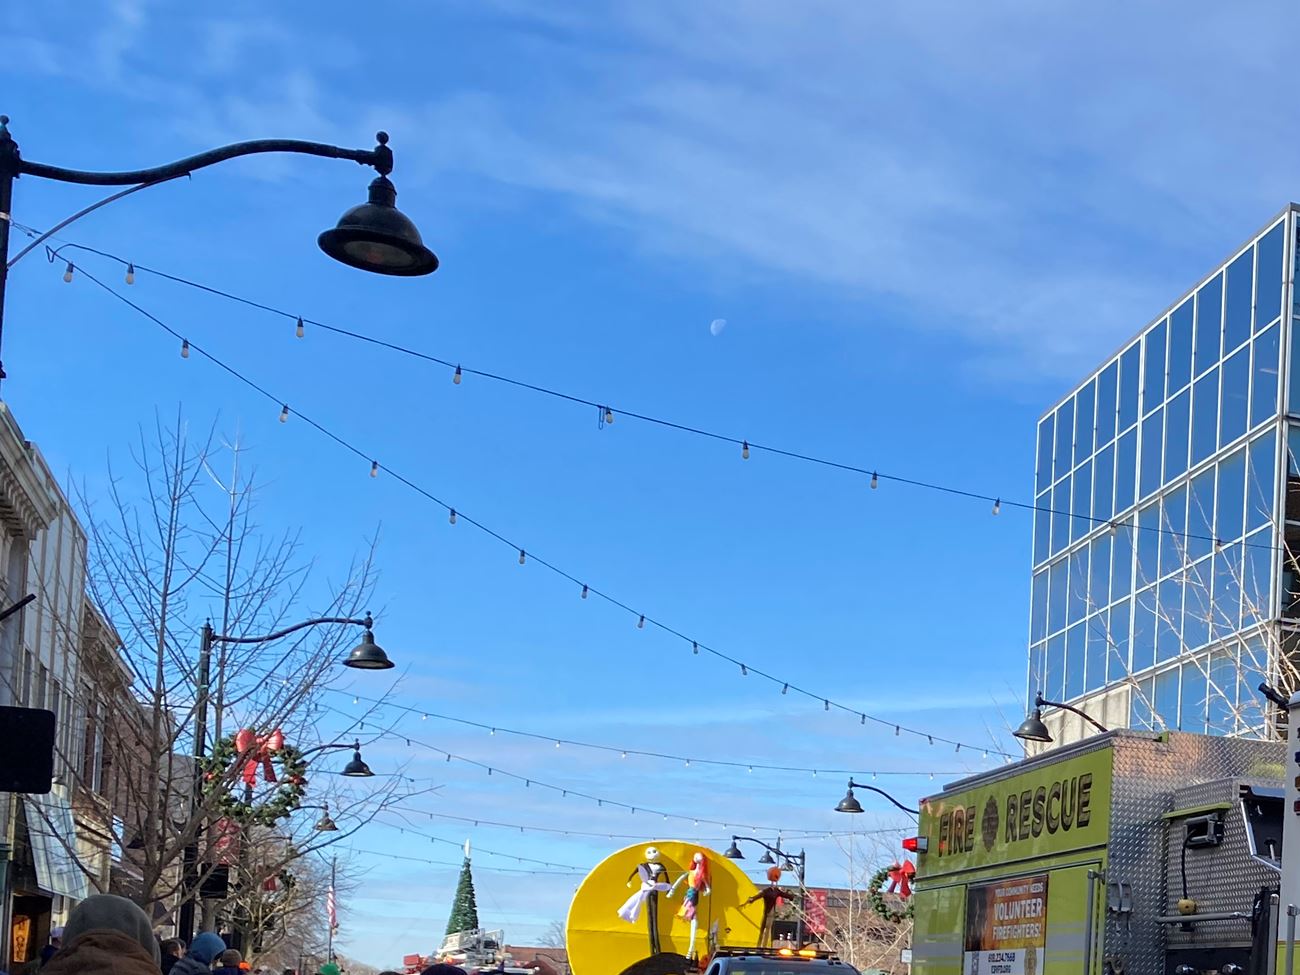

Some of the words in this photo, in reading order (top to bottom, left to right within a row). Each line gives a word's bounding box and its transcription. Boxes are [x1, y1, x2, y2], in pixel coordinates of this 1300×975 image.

[938, 805, 976, 857] FIRE
[1005, 772, 1093, 844] RESCUE
[994, 898, 1043, 921] VOLUNTEER
